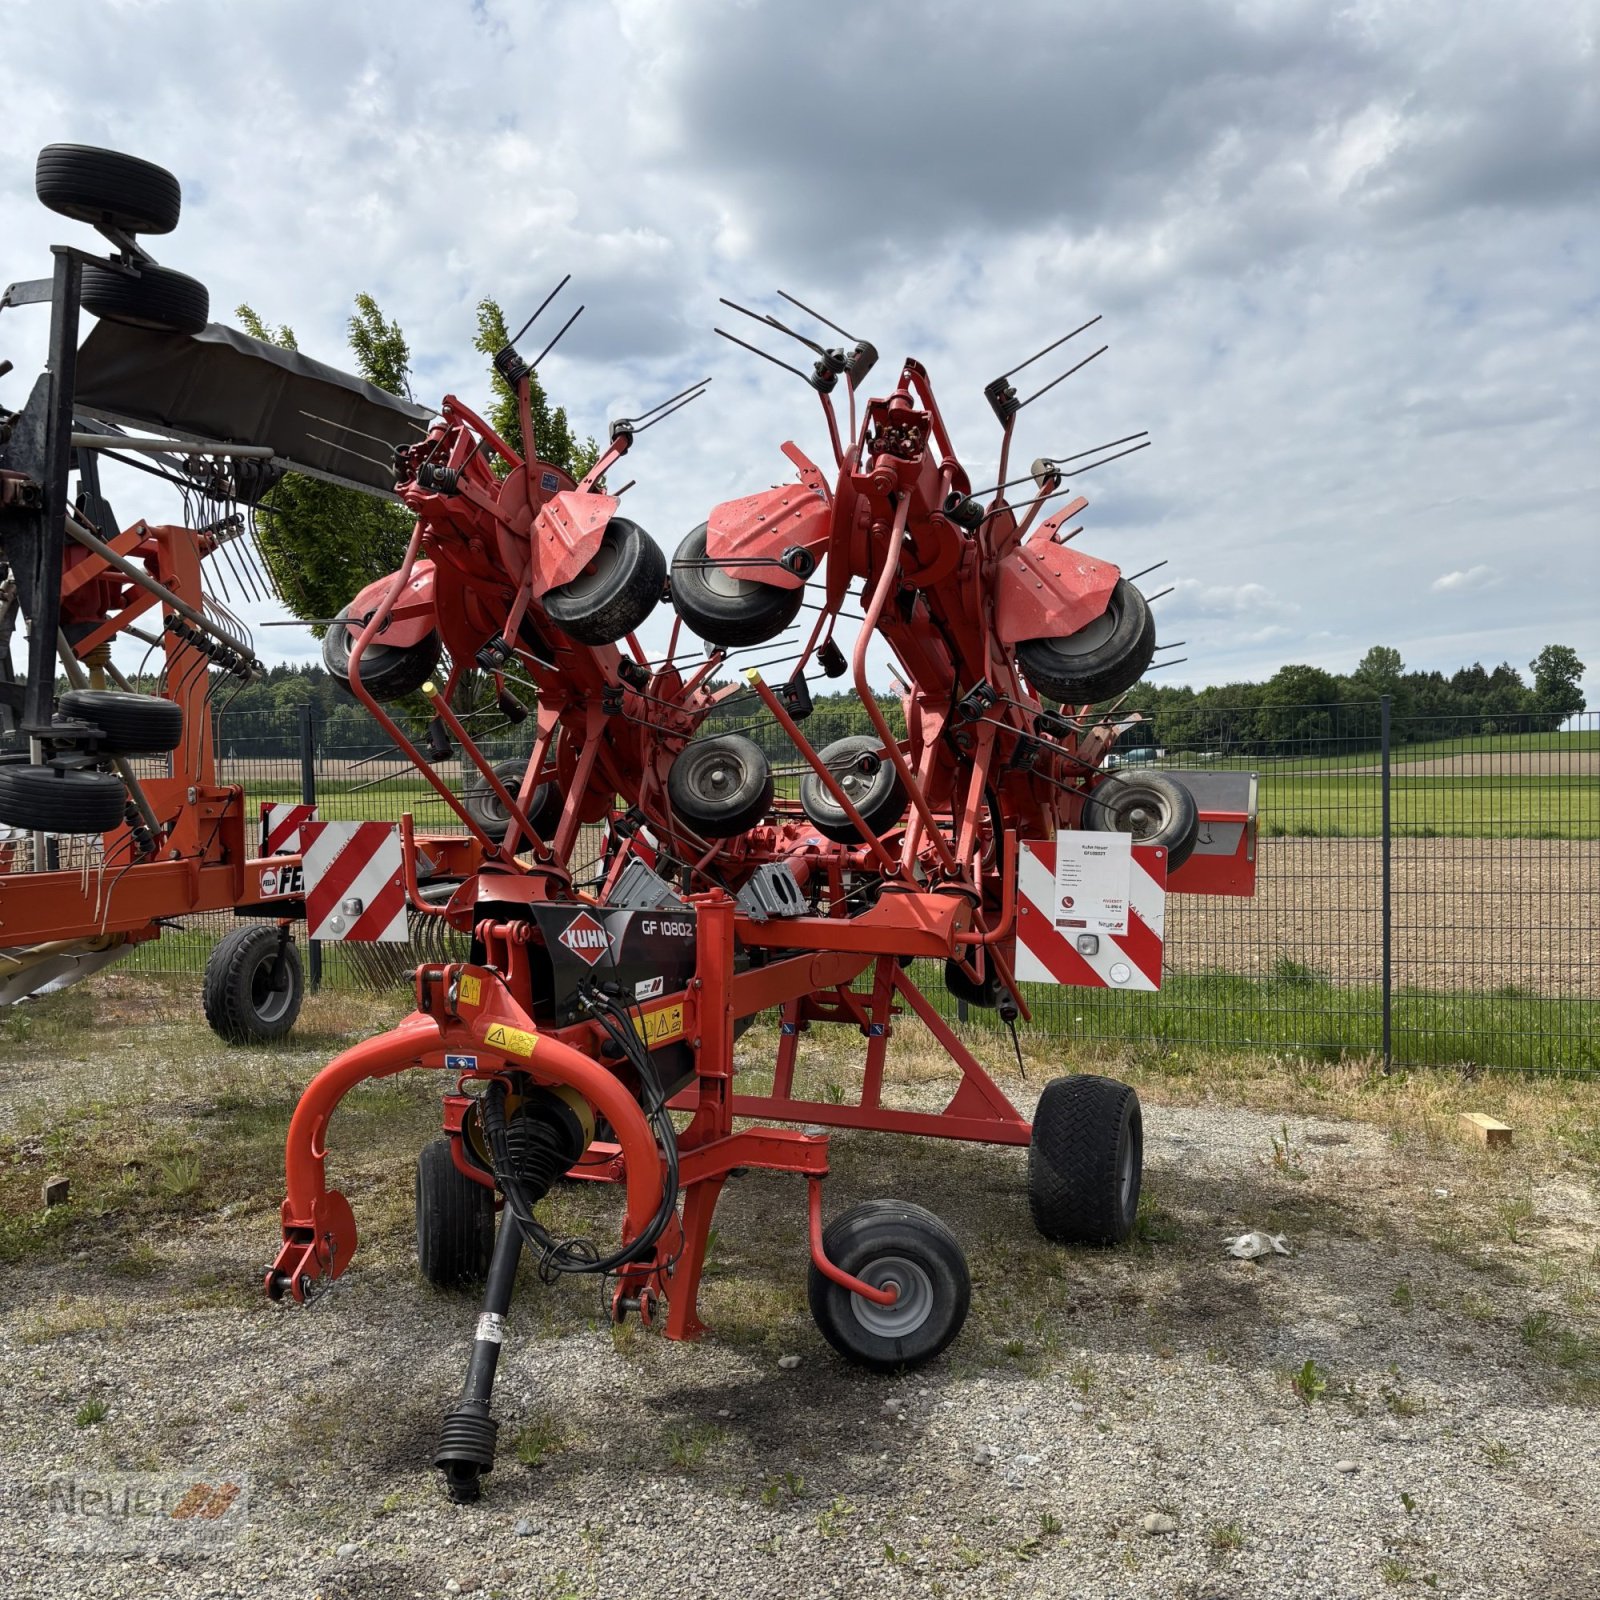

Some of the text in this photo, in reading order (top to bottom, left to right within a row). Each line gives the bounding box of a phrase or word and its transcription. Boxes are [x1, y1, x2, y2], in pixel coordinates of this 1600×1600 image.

[262, 878, 276, 887] FELLA
[279, 865, 305, 894] FE
[641, 920, 693, 937] GF 10802
[567, 929, 609, 949] KUHN
